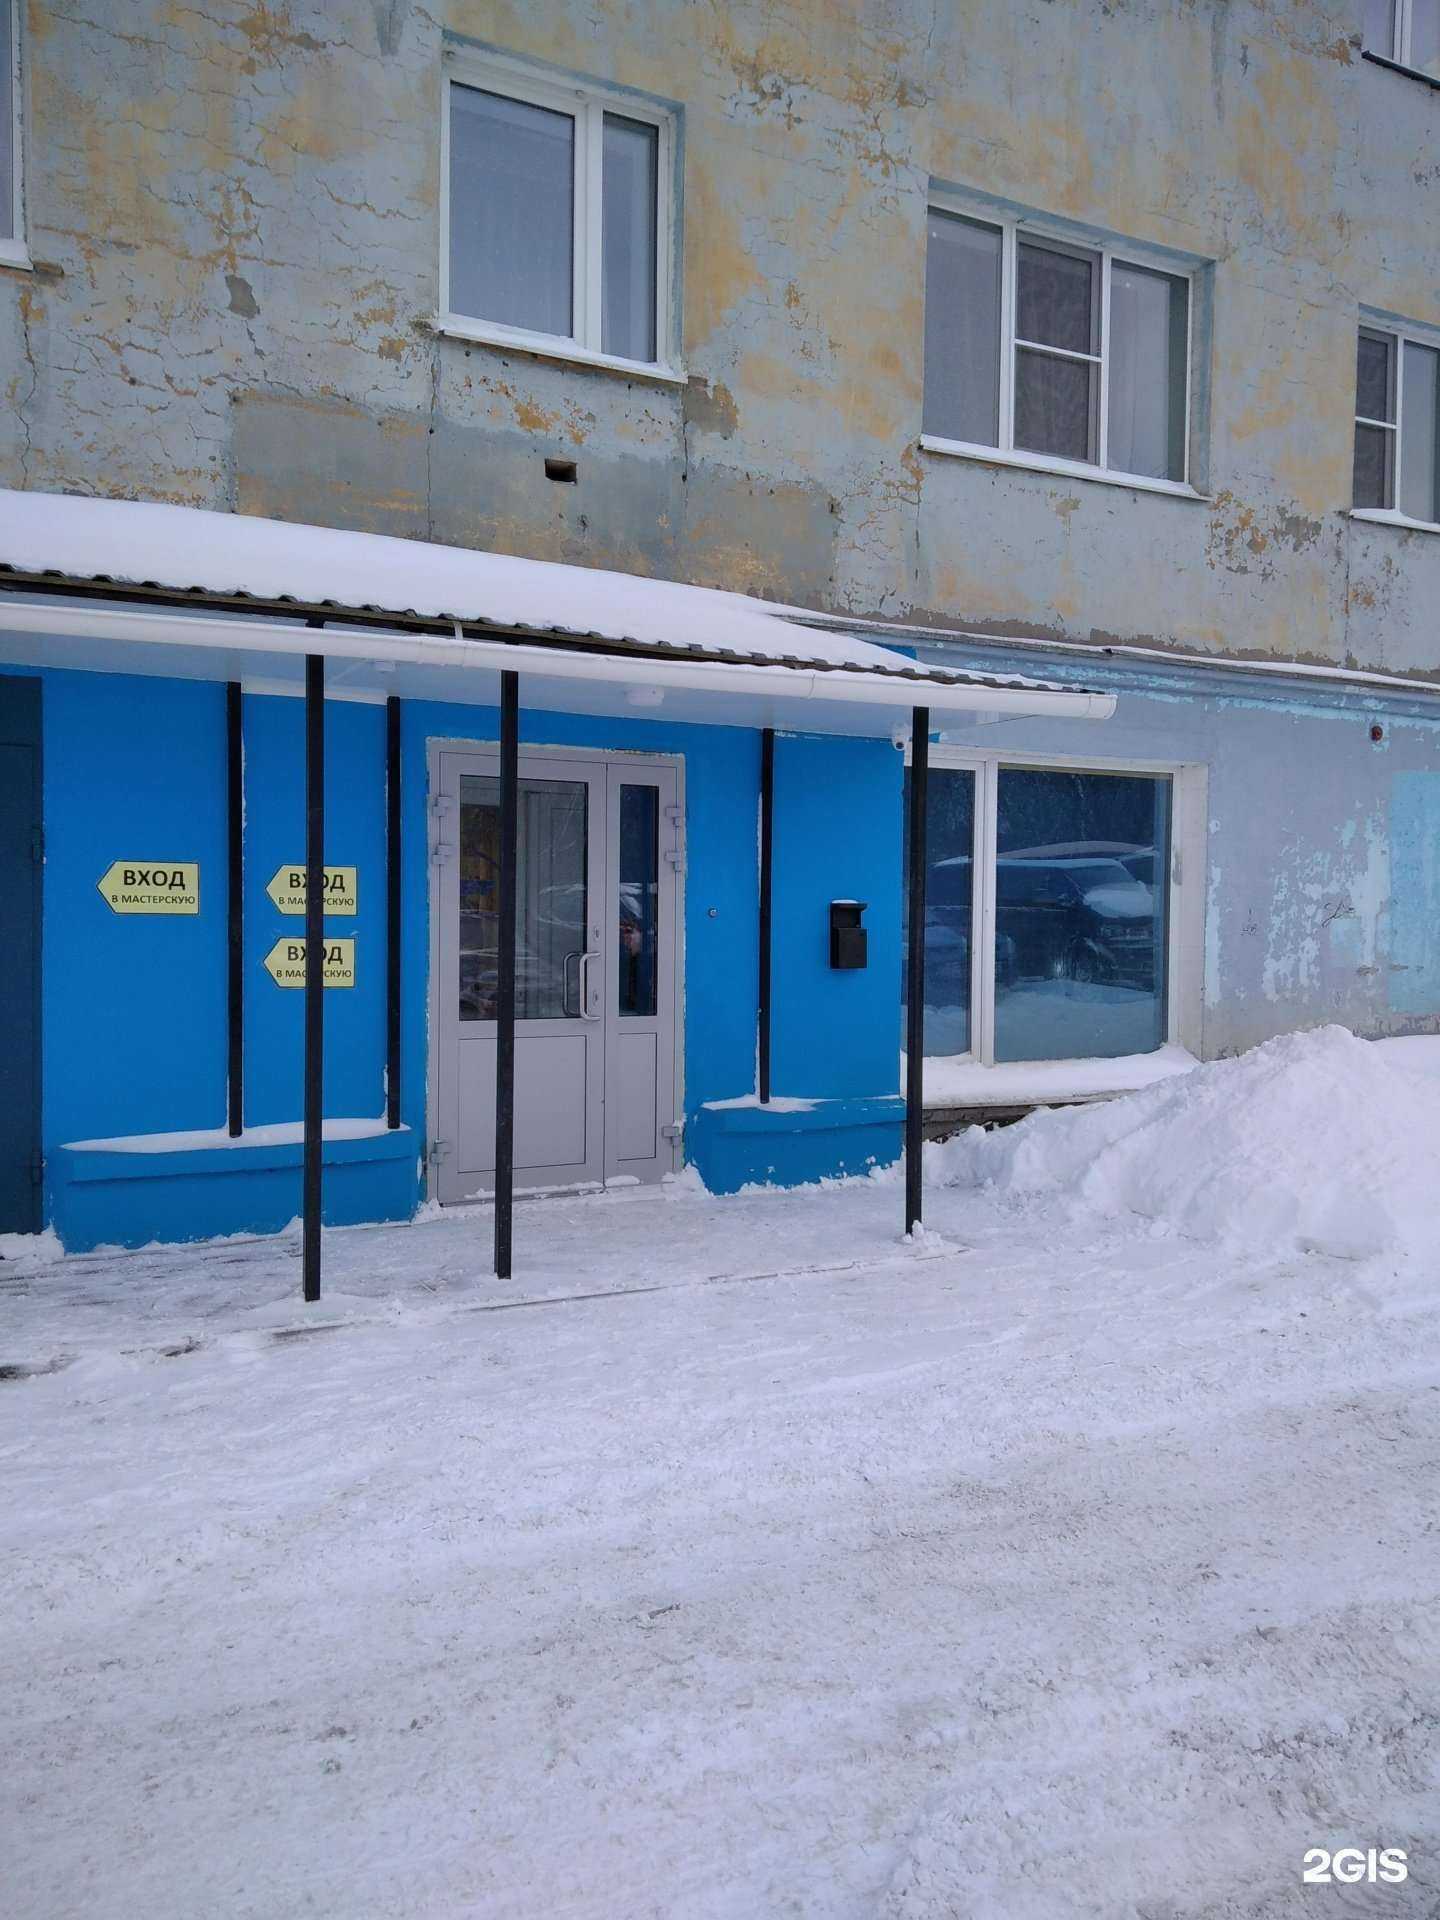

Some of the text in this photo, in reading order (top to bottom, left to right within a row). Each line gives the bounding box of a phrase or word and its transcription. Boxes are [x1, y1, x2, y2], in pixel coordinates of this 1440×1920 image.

[123, 869, 186, 891] ВХОД
[111, 894, 196, 905] В МАСТЕРСКУЮ
[278, 896, 354, 906] В МАРСКУЮ
[276, 969, 352, 978] В МАССКУЮ
